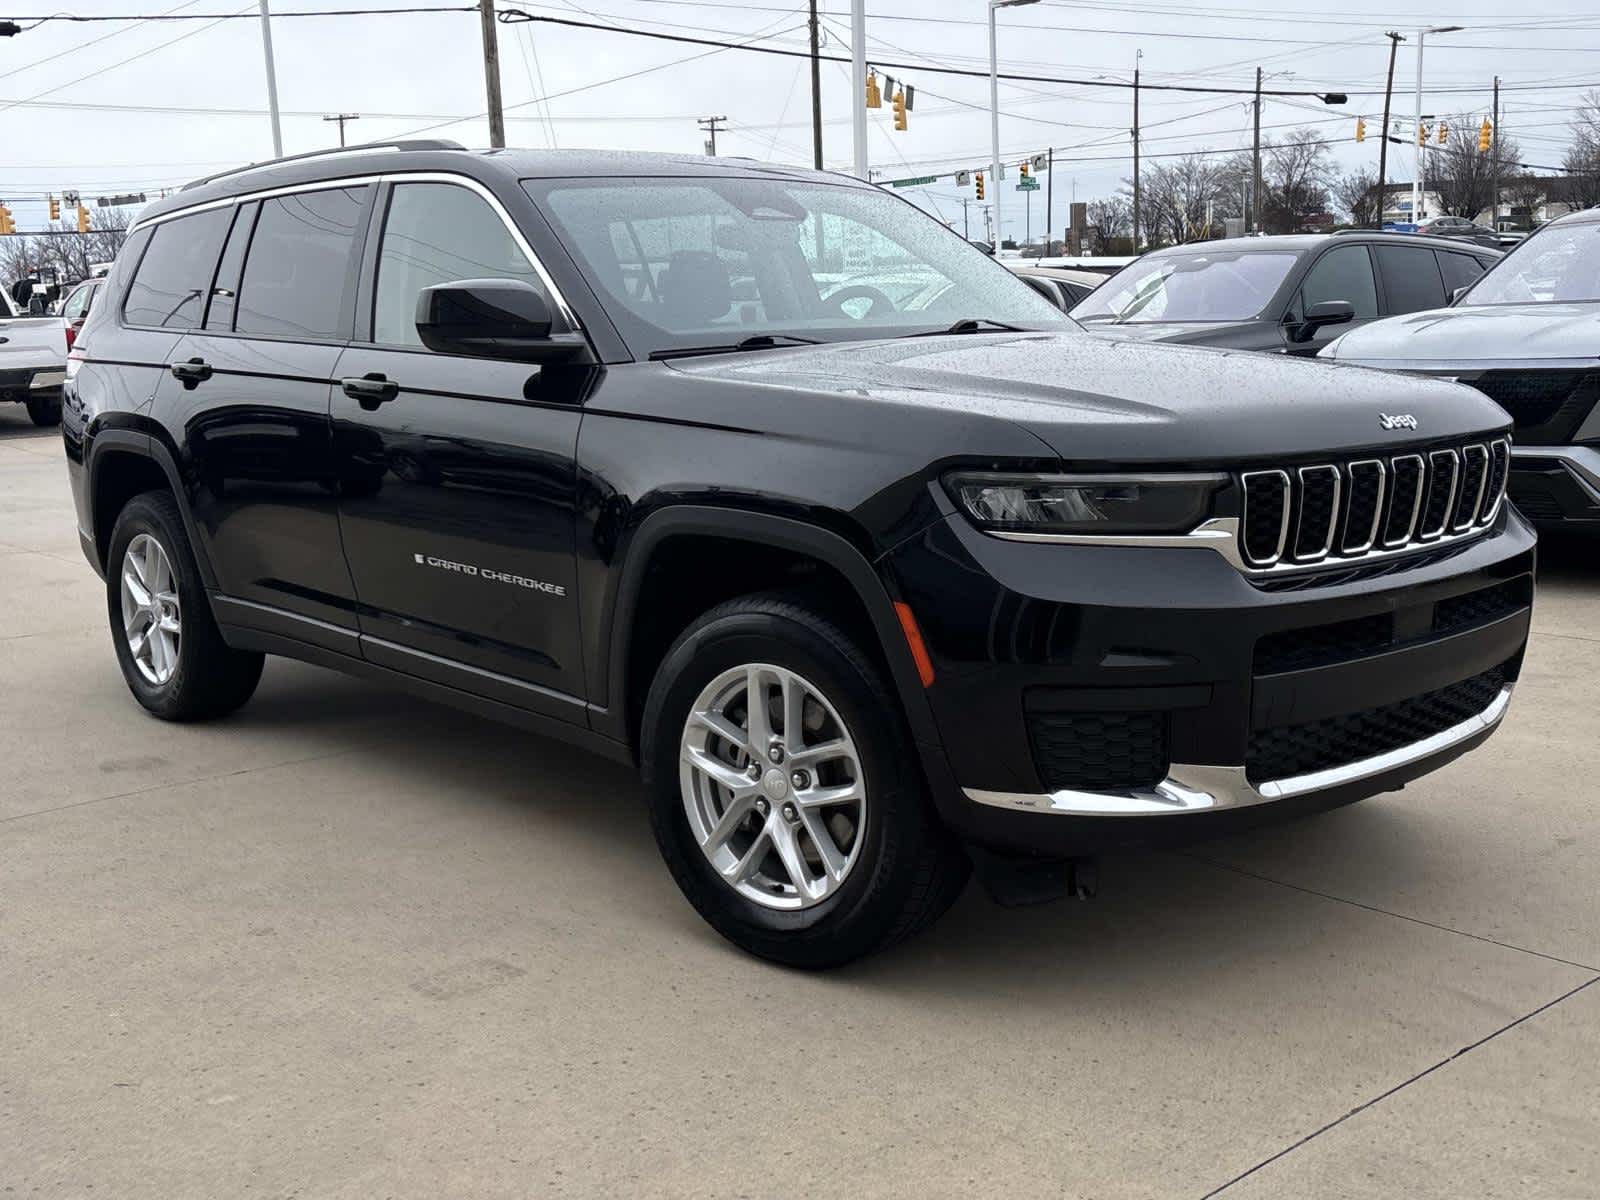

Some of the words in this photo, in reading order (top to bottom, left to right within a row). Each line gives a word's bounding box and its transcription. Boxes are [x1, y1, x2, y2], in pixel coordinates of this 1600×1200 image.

[1378, 412, 1418, 429] Jeep
[427, 556, 478, 576] GRAND
[480, 568, 566, 596] CHEROKEE
